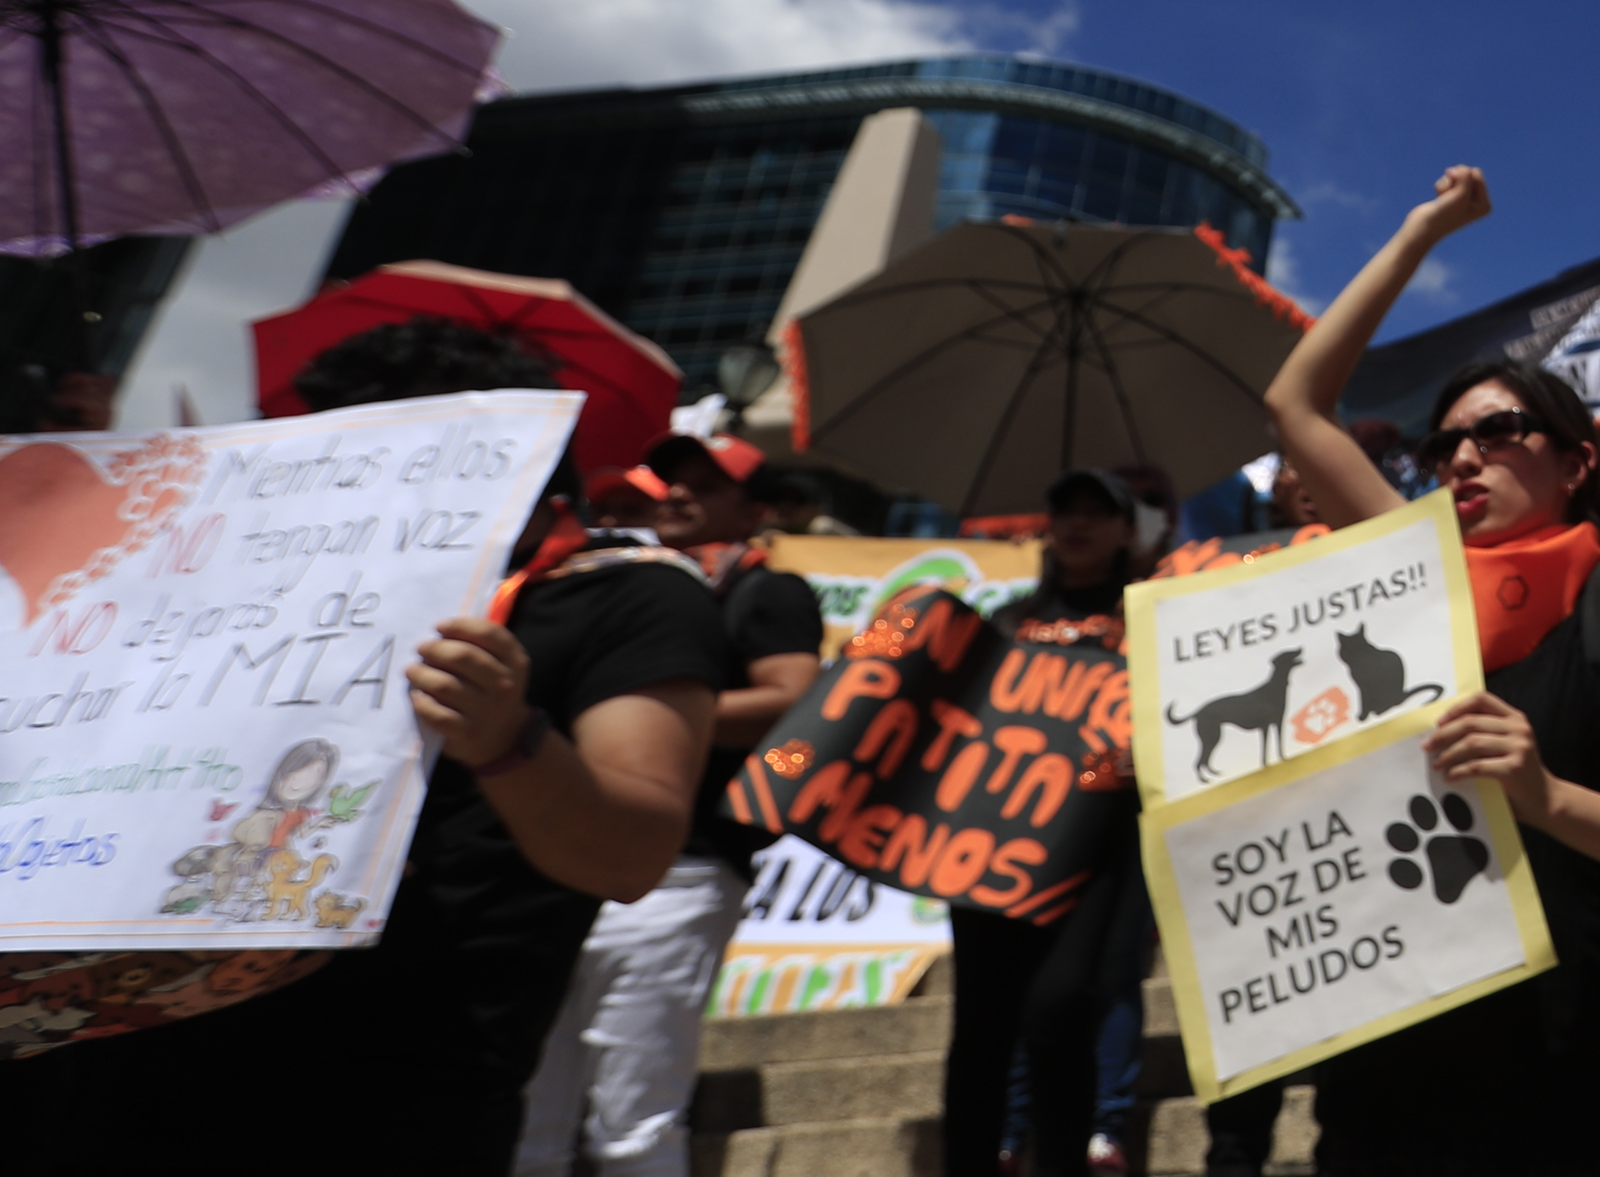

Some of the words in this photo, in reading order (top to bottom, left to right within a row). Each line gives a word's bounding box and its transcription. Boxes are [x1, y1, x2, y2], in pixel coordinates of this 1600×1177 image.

[402, 423, 517, 483] ellos
[147, 513, 226, 580] NO
[233, 511, 380, 593] tengan
[28, 601, 118, 657] NO
[318, 571, 381, 629] de
[1173, 613, 1278, 663] LEYES
[1289, 561, 1428, 634] JUSTAS!!
[786, 759, 1048, 908] MENOS
[1211, 827, 1292, 887] SOY
[1302, 810, 1353, 852] LA
[1216, 870, 1301, 928] VOZ
[1312, 847, 1367, 893] DE
[1264, 905, 1339, 959] MIS
[1218, 925, 1405, 1024] PELUDOS
